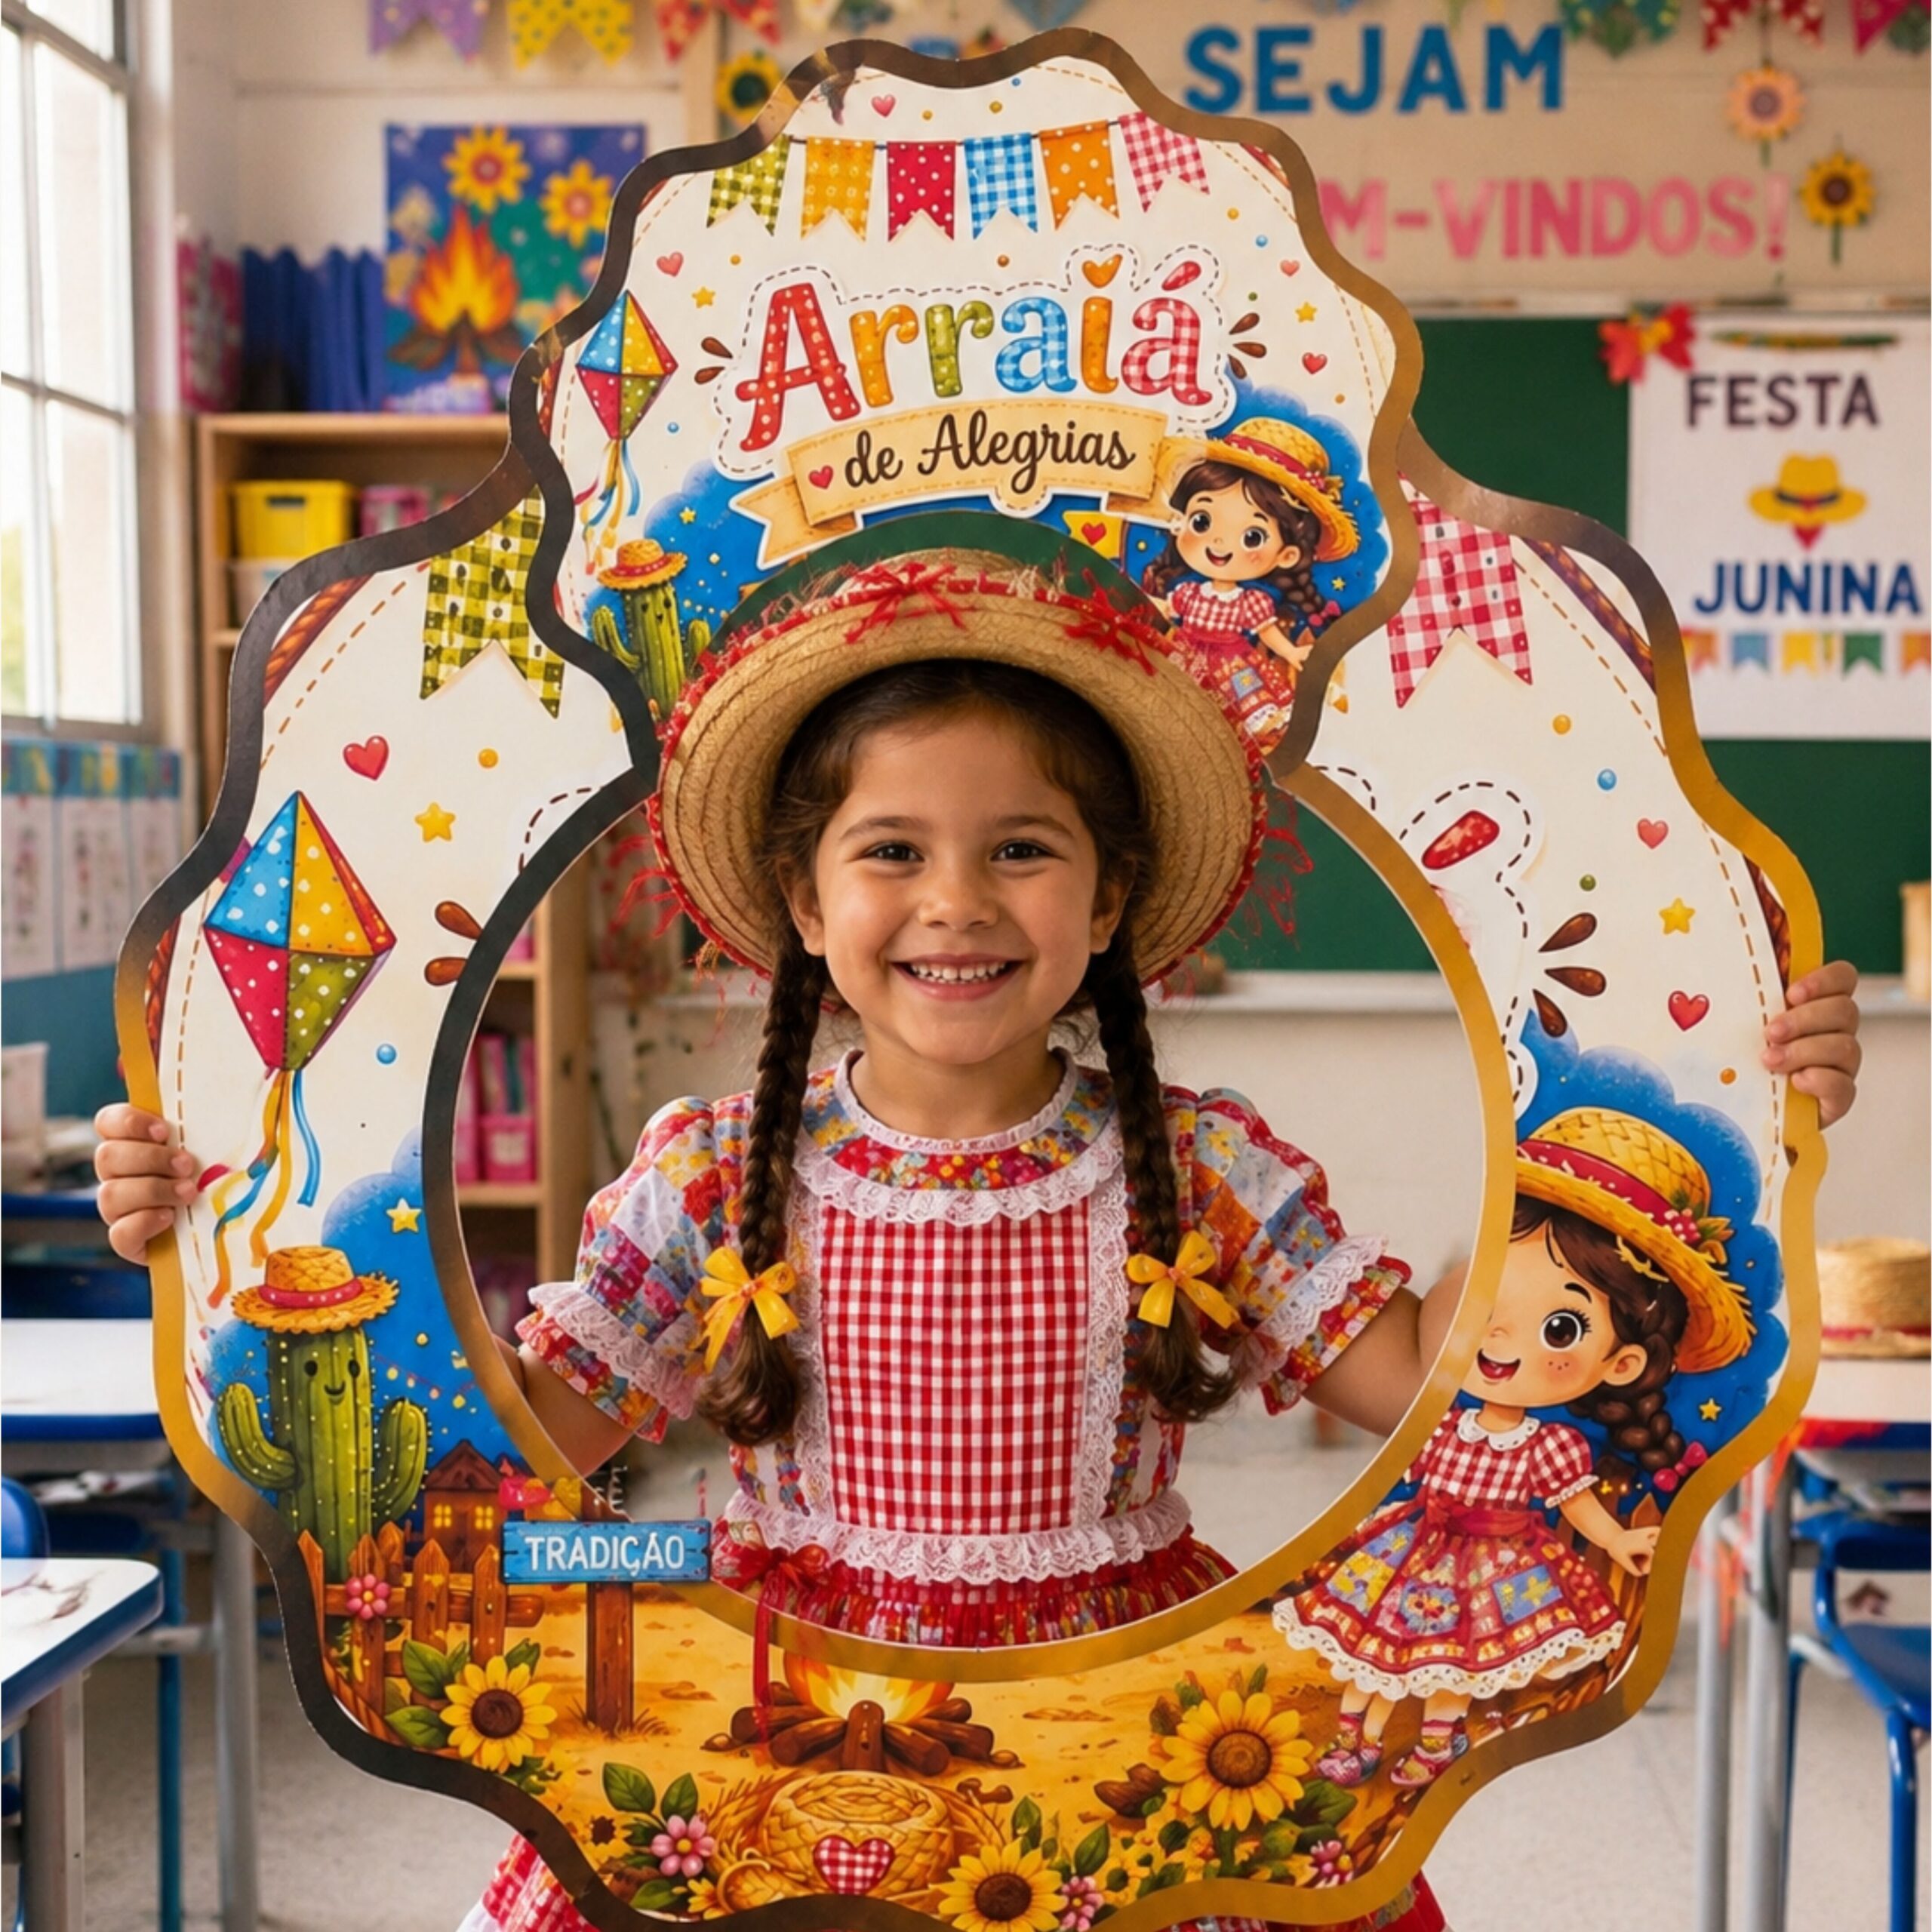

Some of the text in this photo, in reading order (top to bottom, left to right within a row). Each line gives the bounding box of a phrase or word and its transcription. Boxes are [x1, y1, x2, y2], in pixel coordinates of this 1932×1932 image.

[1184, 23, 1565, 115] SEJAM
[735, 254, 1214, 452] Arraiá
[1687, 372, 1881, 428] FESTA
[844, 409, 1137, 494] de Alegrias
[1694, 560, 1923, 616] JUNINA
